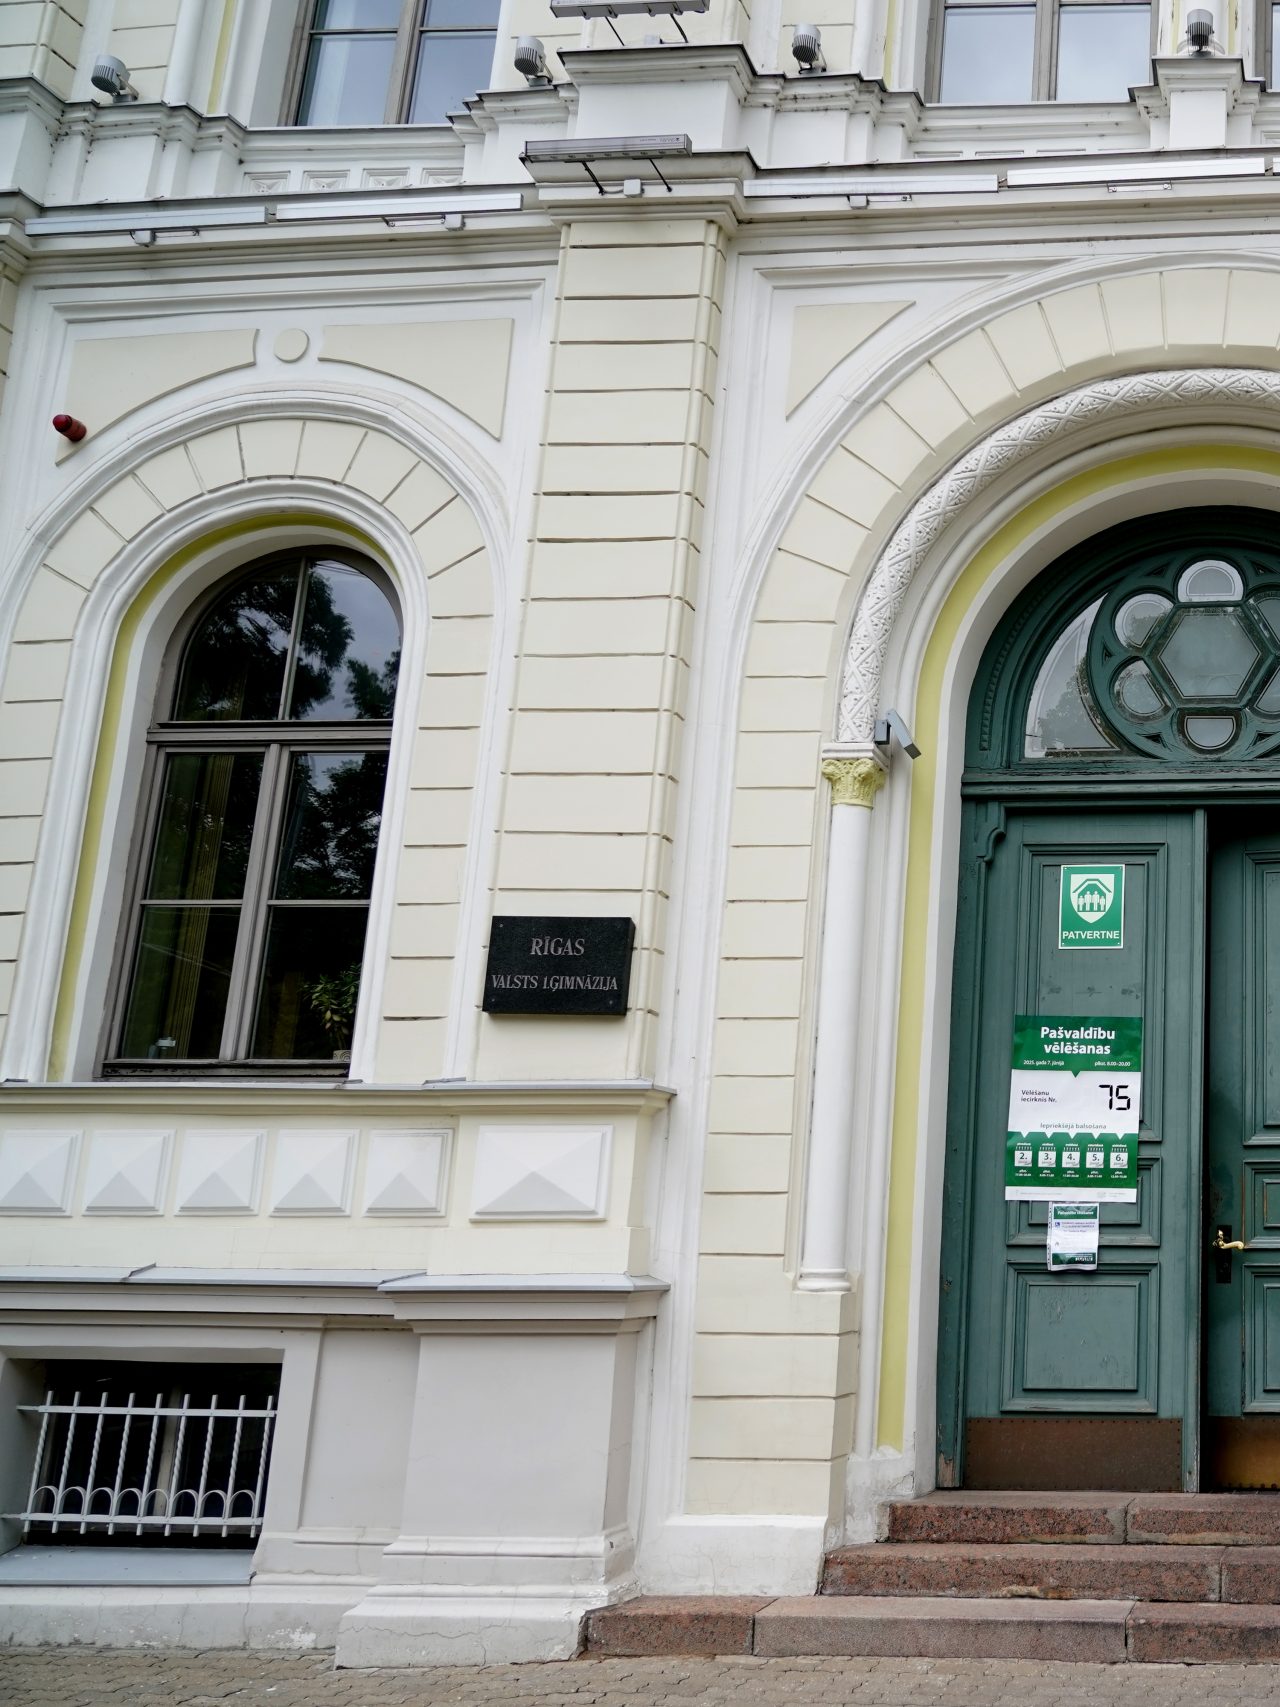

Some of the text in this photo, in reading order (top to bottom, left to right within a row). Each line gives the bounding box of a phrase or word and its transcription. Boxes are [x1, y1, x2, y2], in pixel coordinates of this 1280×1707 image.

[1062, 930, 1120, 940] PATVERTNE
[529, 936, 586, 956] RĪGAS
[491, 974, 539, 989] VALSTS
[1040, 1026, 1116, 1040] Pašvaldību
[1043, 1041, 1111, 1055] vēlēšanas
[1098, 1084, 1131, 1111] 75
[1019, 1152, 1028, 1160] 2.
[1043, 1152, 1052, 1161] 3.
[1066, 1153, 1076, 1161] 4.
[1092, 1153, 1100, 1162] 5.
[1115, 1153, 1124, 1162] 6.
